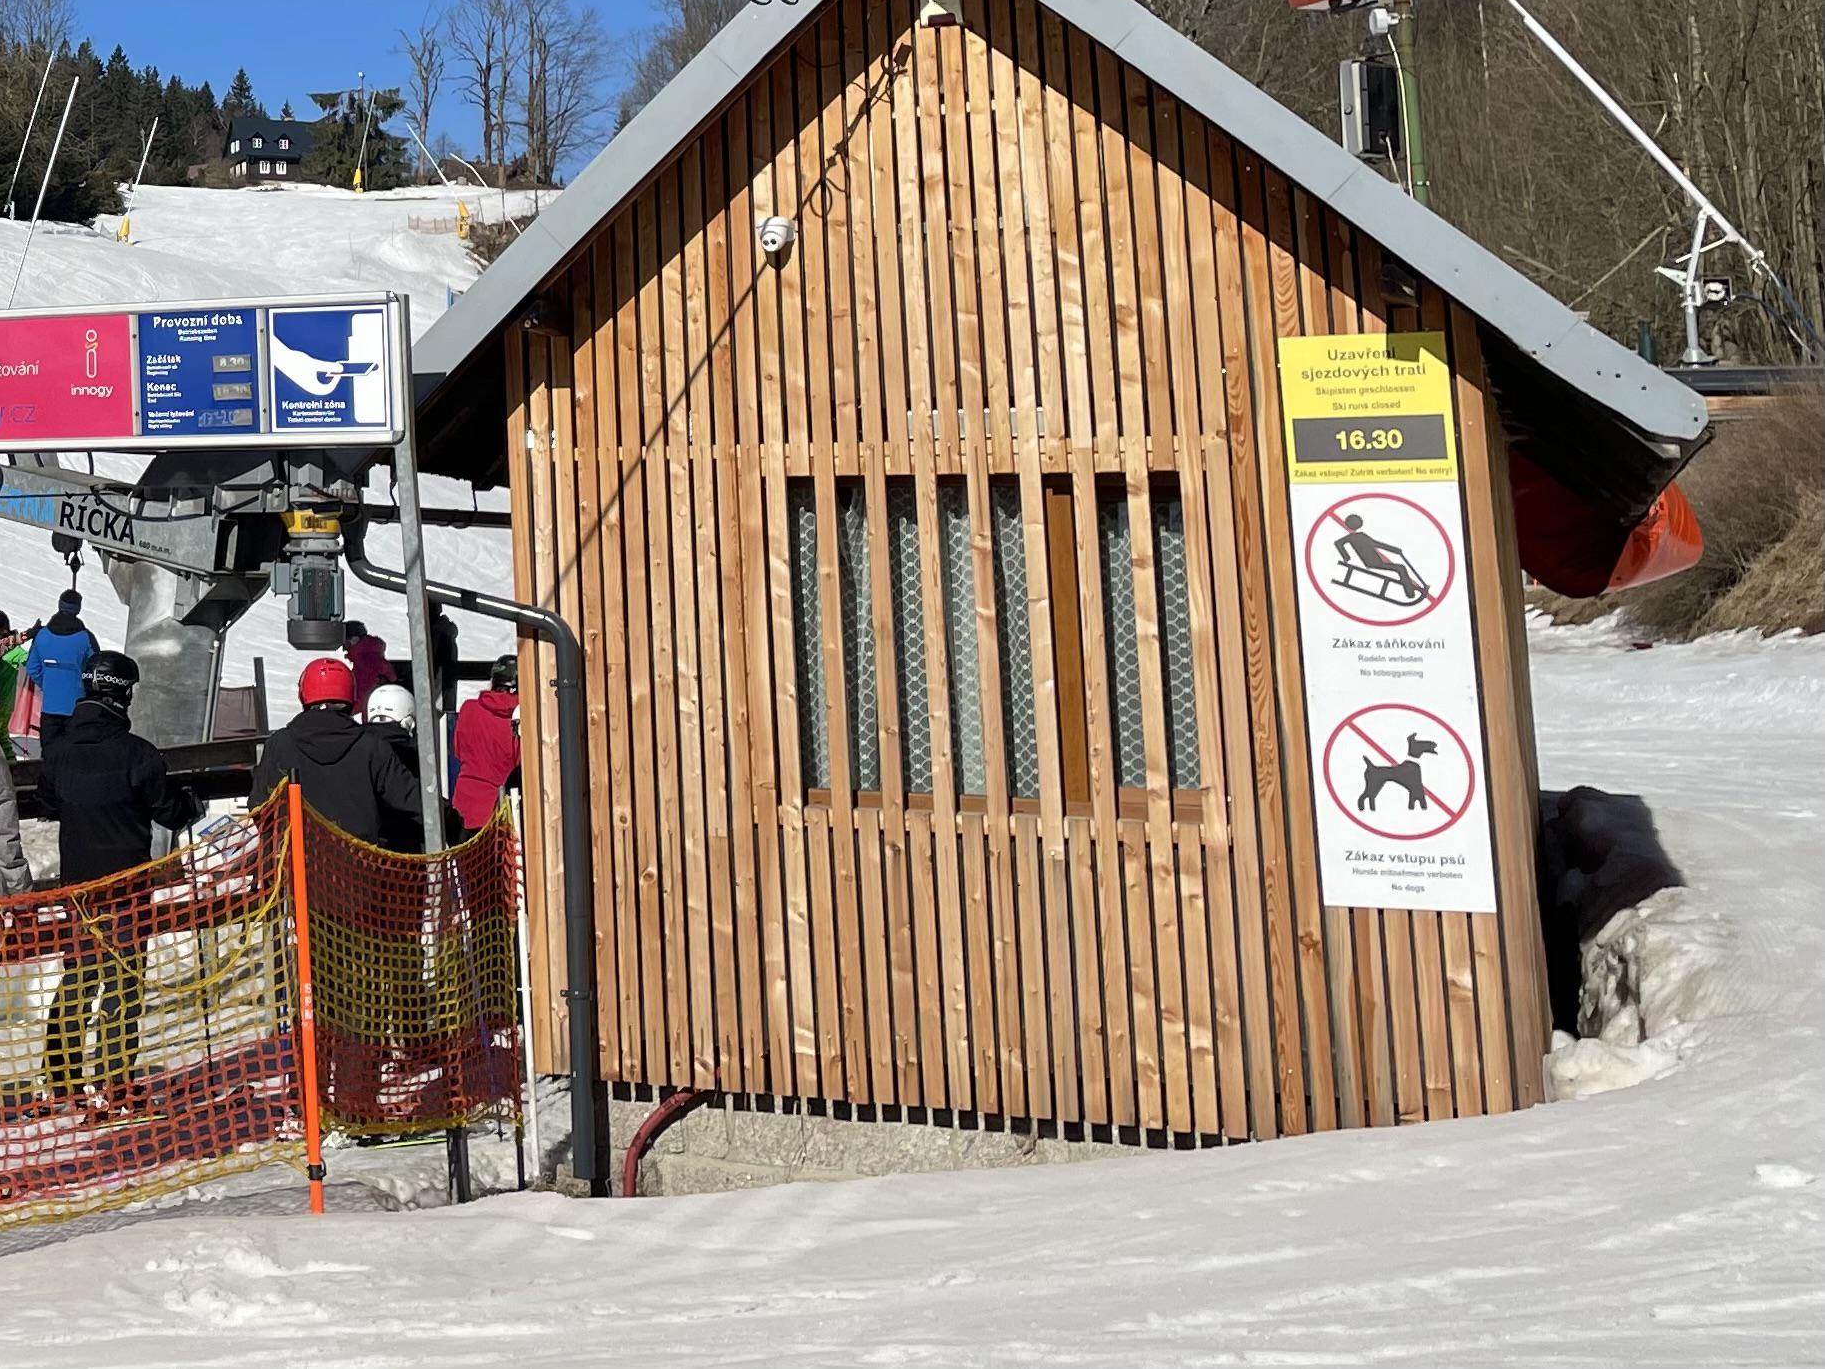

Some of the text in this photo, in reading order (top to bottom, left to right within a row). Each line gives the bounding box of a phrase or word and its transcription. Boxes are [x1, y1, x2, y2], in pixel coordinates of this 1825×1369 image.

[153, 315, 208, 328] Provozní
[1327, 347, 1395, 361] Uzavření
[1301, 365, 1389, 381] sjezdových
[70, 384, 114, 397] innogy
[281, 401, 322, 410] Kontrolní
[1332, 403, 1347, 411] Ski
[1371, 401, 1401, 409] closed
[1335, 429, 1403, 451] 16.30
[59, 490, 135, 545] ŘÍČKA
[1332, 638, 1445, 649] Zákaz sáňkování
[1345, 851, 1466, 867] Zákaz vstupu psů
